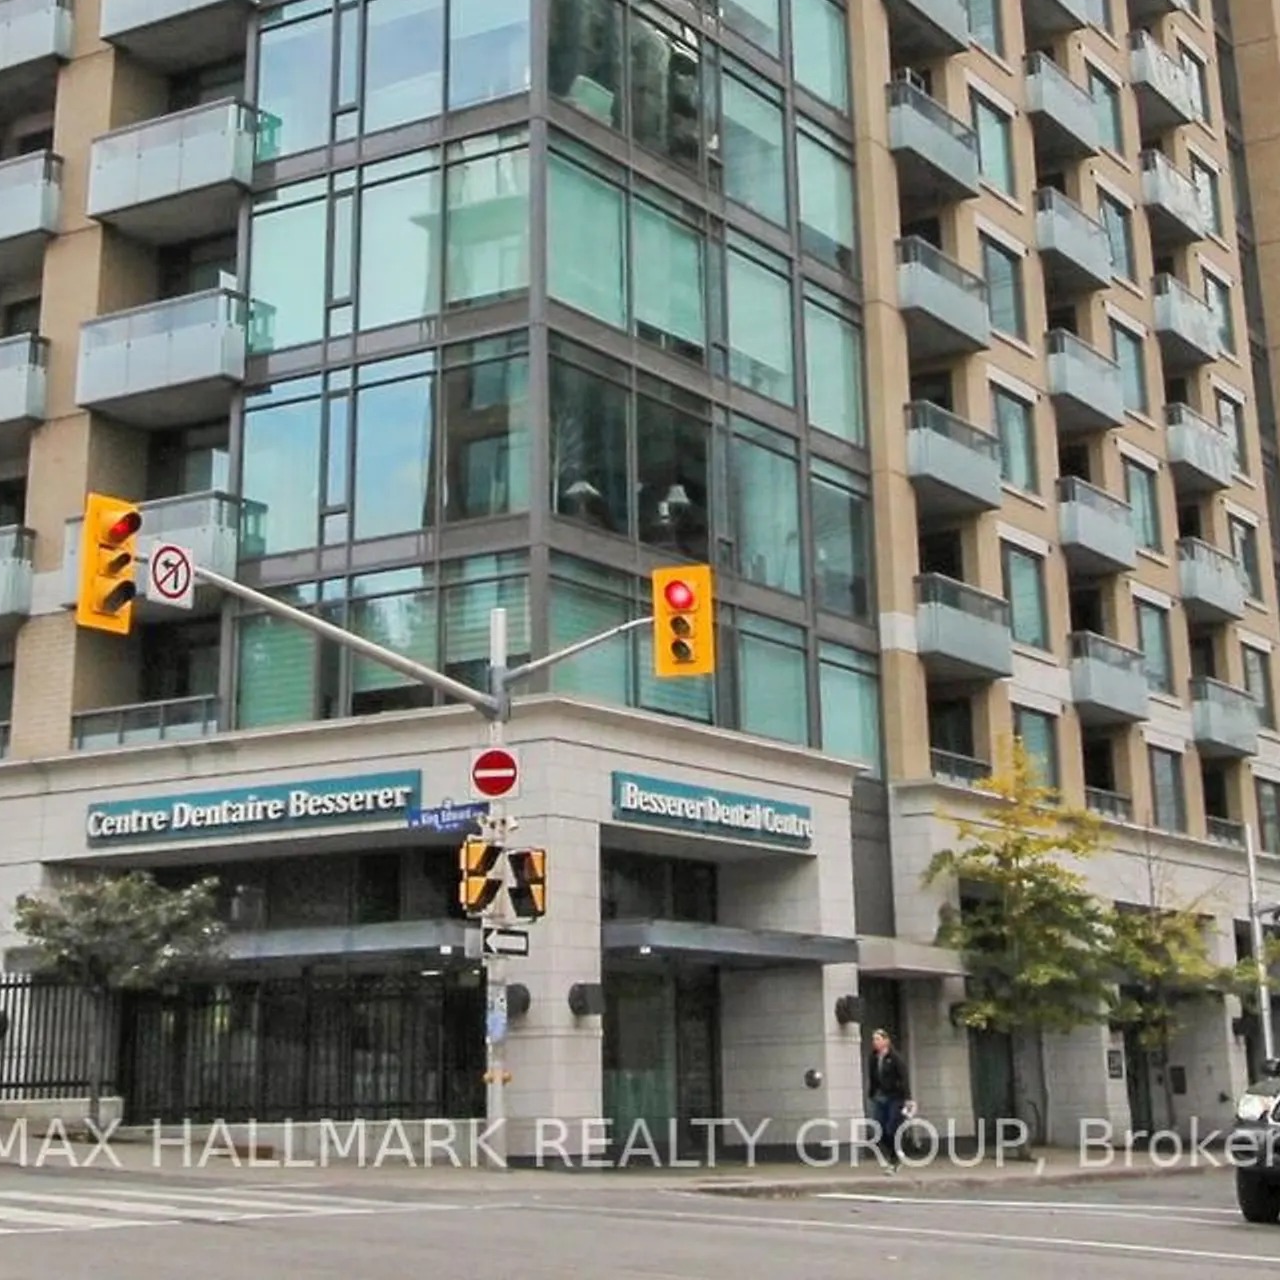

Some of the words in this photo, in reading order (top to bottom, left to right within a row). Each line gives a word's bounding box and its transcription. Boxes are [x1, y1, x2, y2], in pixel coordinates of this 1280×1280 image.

[87, 808, 166, 837] Centre
[171, 795, 285, 829] Dentaire
[289, 785, 412, 818] Besserer
[621, 783, 704, 821] Besserer
[705, 796, 761, 830] Dental
[764, 808, 813, 838] Centre
